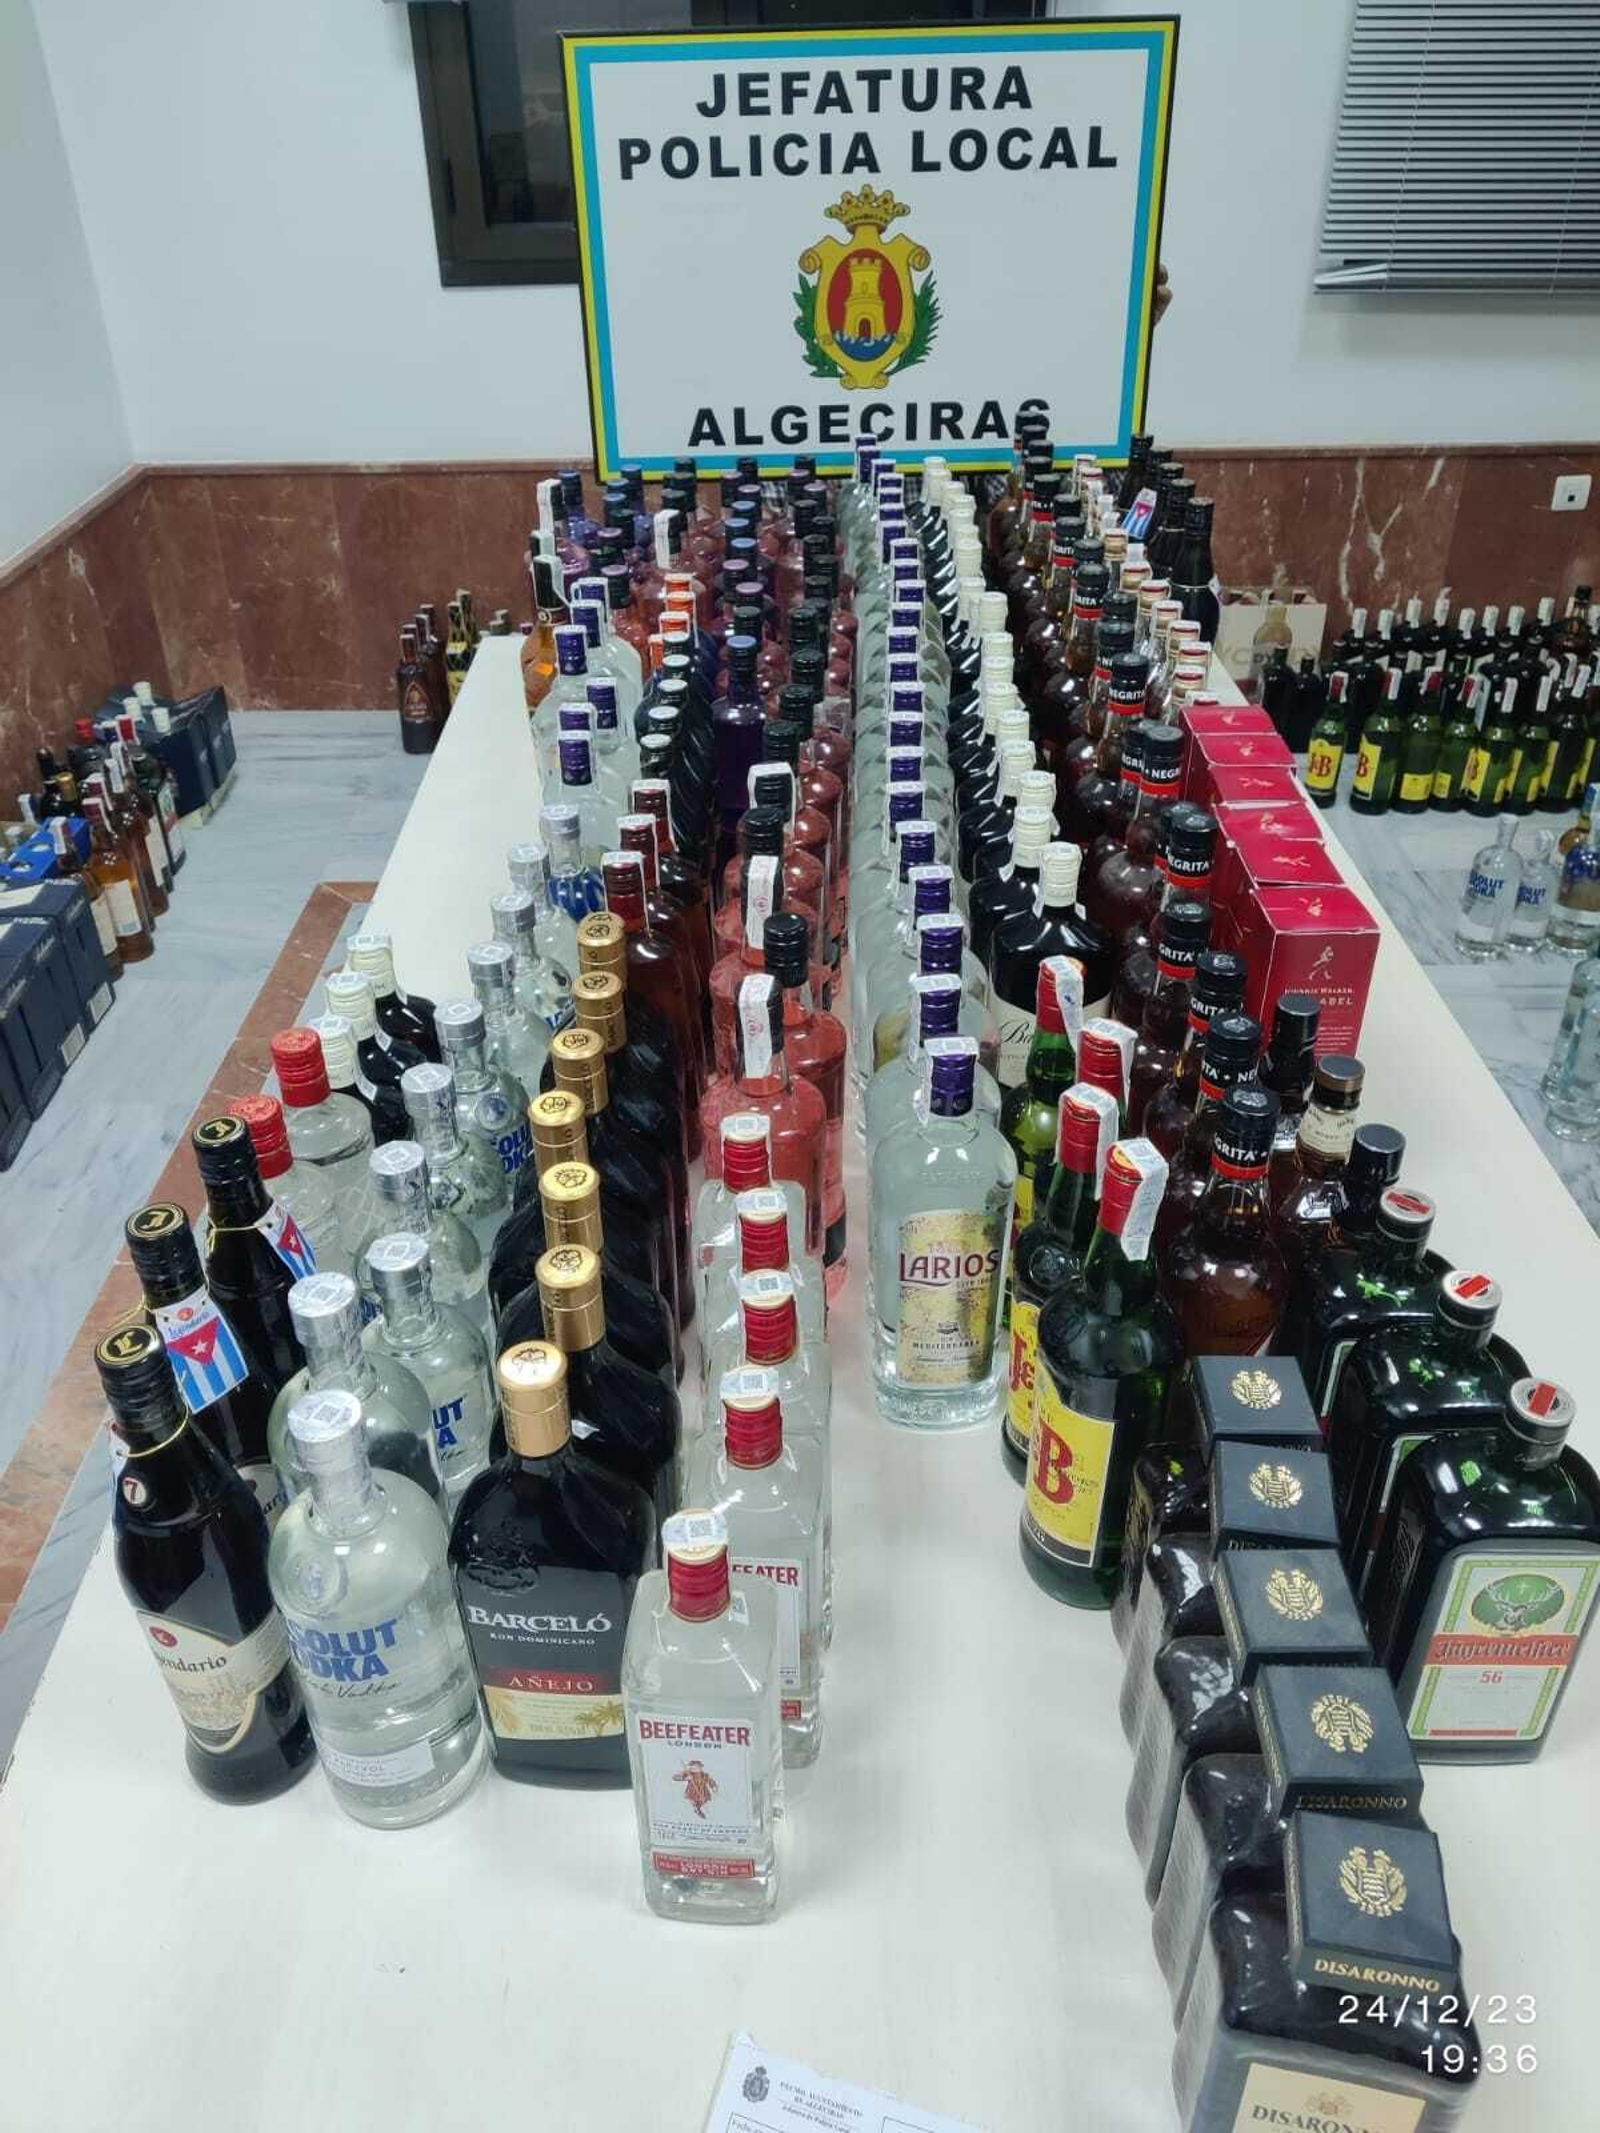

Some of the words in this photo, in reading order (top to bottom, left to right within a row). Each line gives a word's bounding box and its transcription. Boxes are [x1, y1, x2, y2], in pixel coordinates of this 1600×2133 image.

[696, 65, 1033, 118] JEFATURA
[618, 132, 881, 180] POLICIA
[911, 126, 1118, 172] LOCAL
[687, 399, 1051, 447] ALGECIRAS
[898, 1250, 1001, 1283] LARIOS
[467, 1605, 613, 1634] BARCELÓ
[489, 1632, 514, 1643] RON
[518, 1635, 596, 1646] DOMINICANO
[508, 1675, 594, 1693] AÑEJO
[1479, 1669, 1504, 1684] 56
[638, 1719, 752, 1747] BEEFEATER
[667, 1740, 722, 1750] LONDON
[1313, 1957, 1441, 1993] DISARONNO
